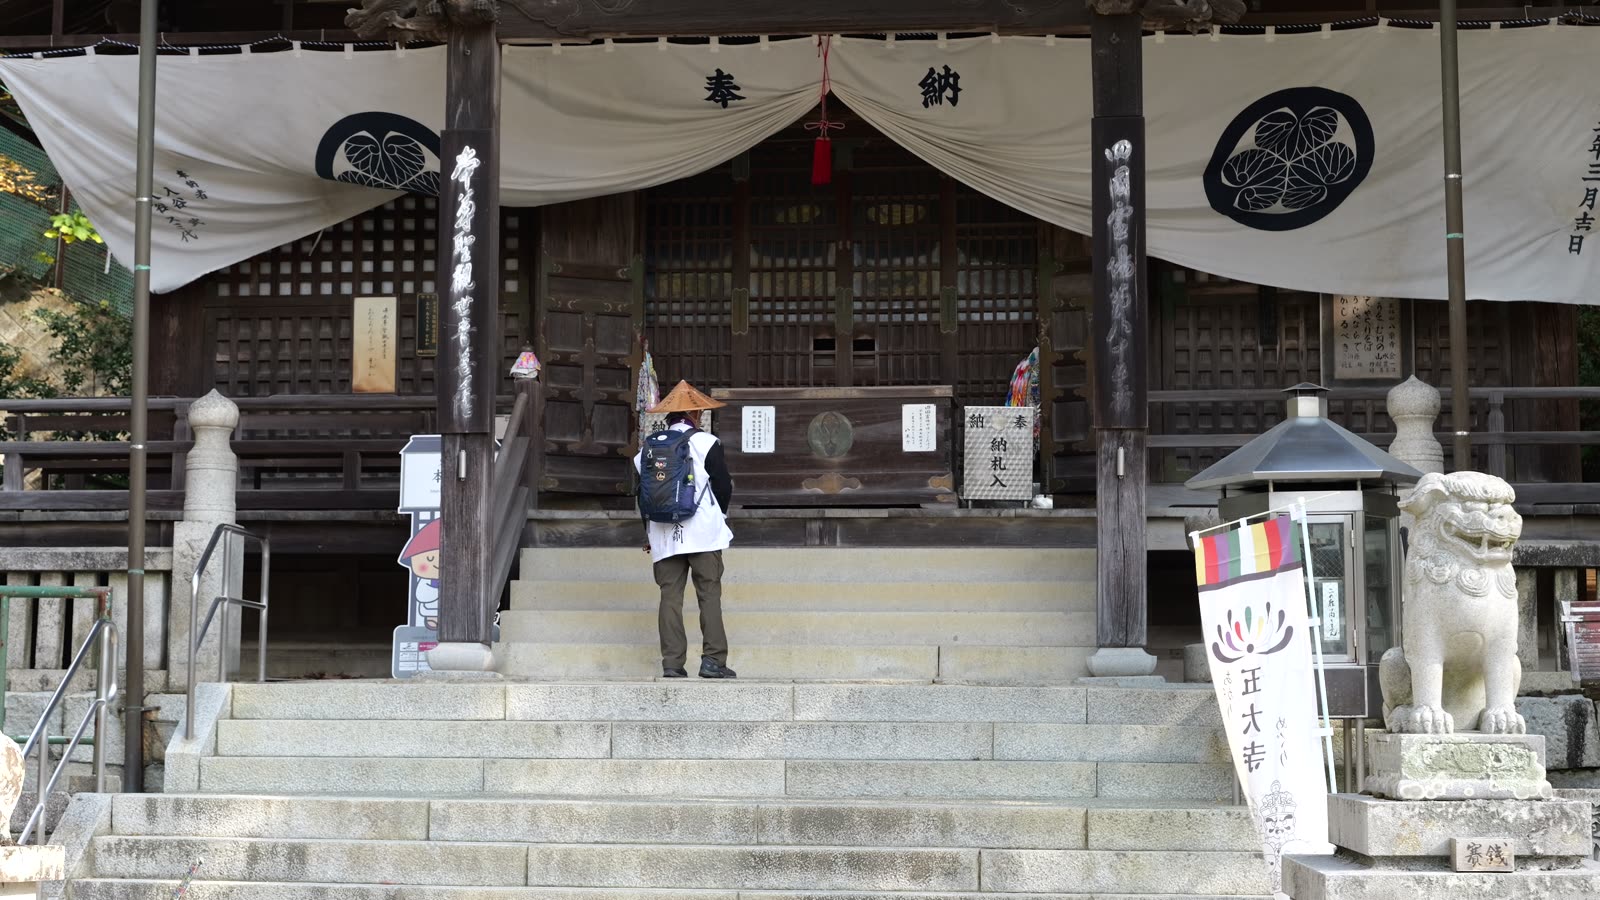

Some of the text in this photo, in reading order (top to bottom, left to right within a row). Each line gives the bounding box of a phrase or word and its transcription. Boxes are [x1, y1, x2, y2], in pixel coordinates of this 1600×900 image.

[704, 64, 963, 109] 奉 納
[1568, 121, 1600, 255] 年三月吉日
[969, 413, 1028, 430] 奉 納
[990, 437, 1007, 488] 納札入
